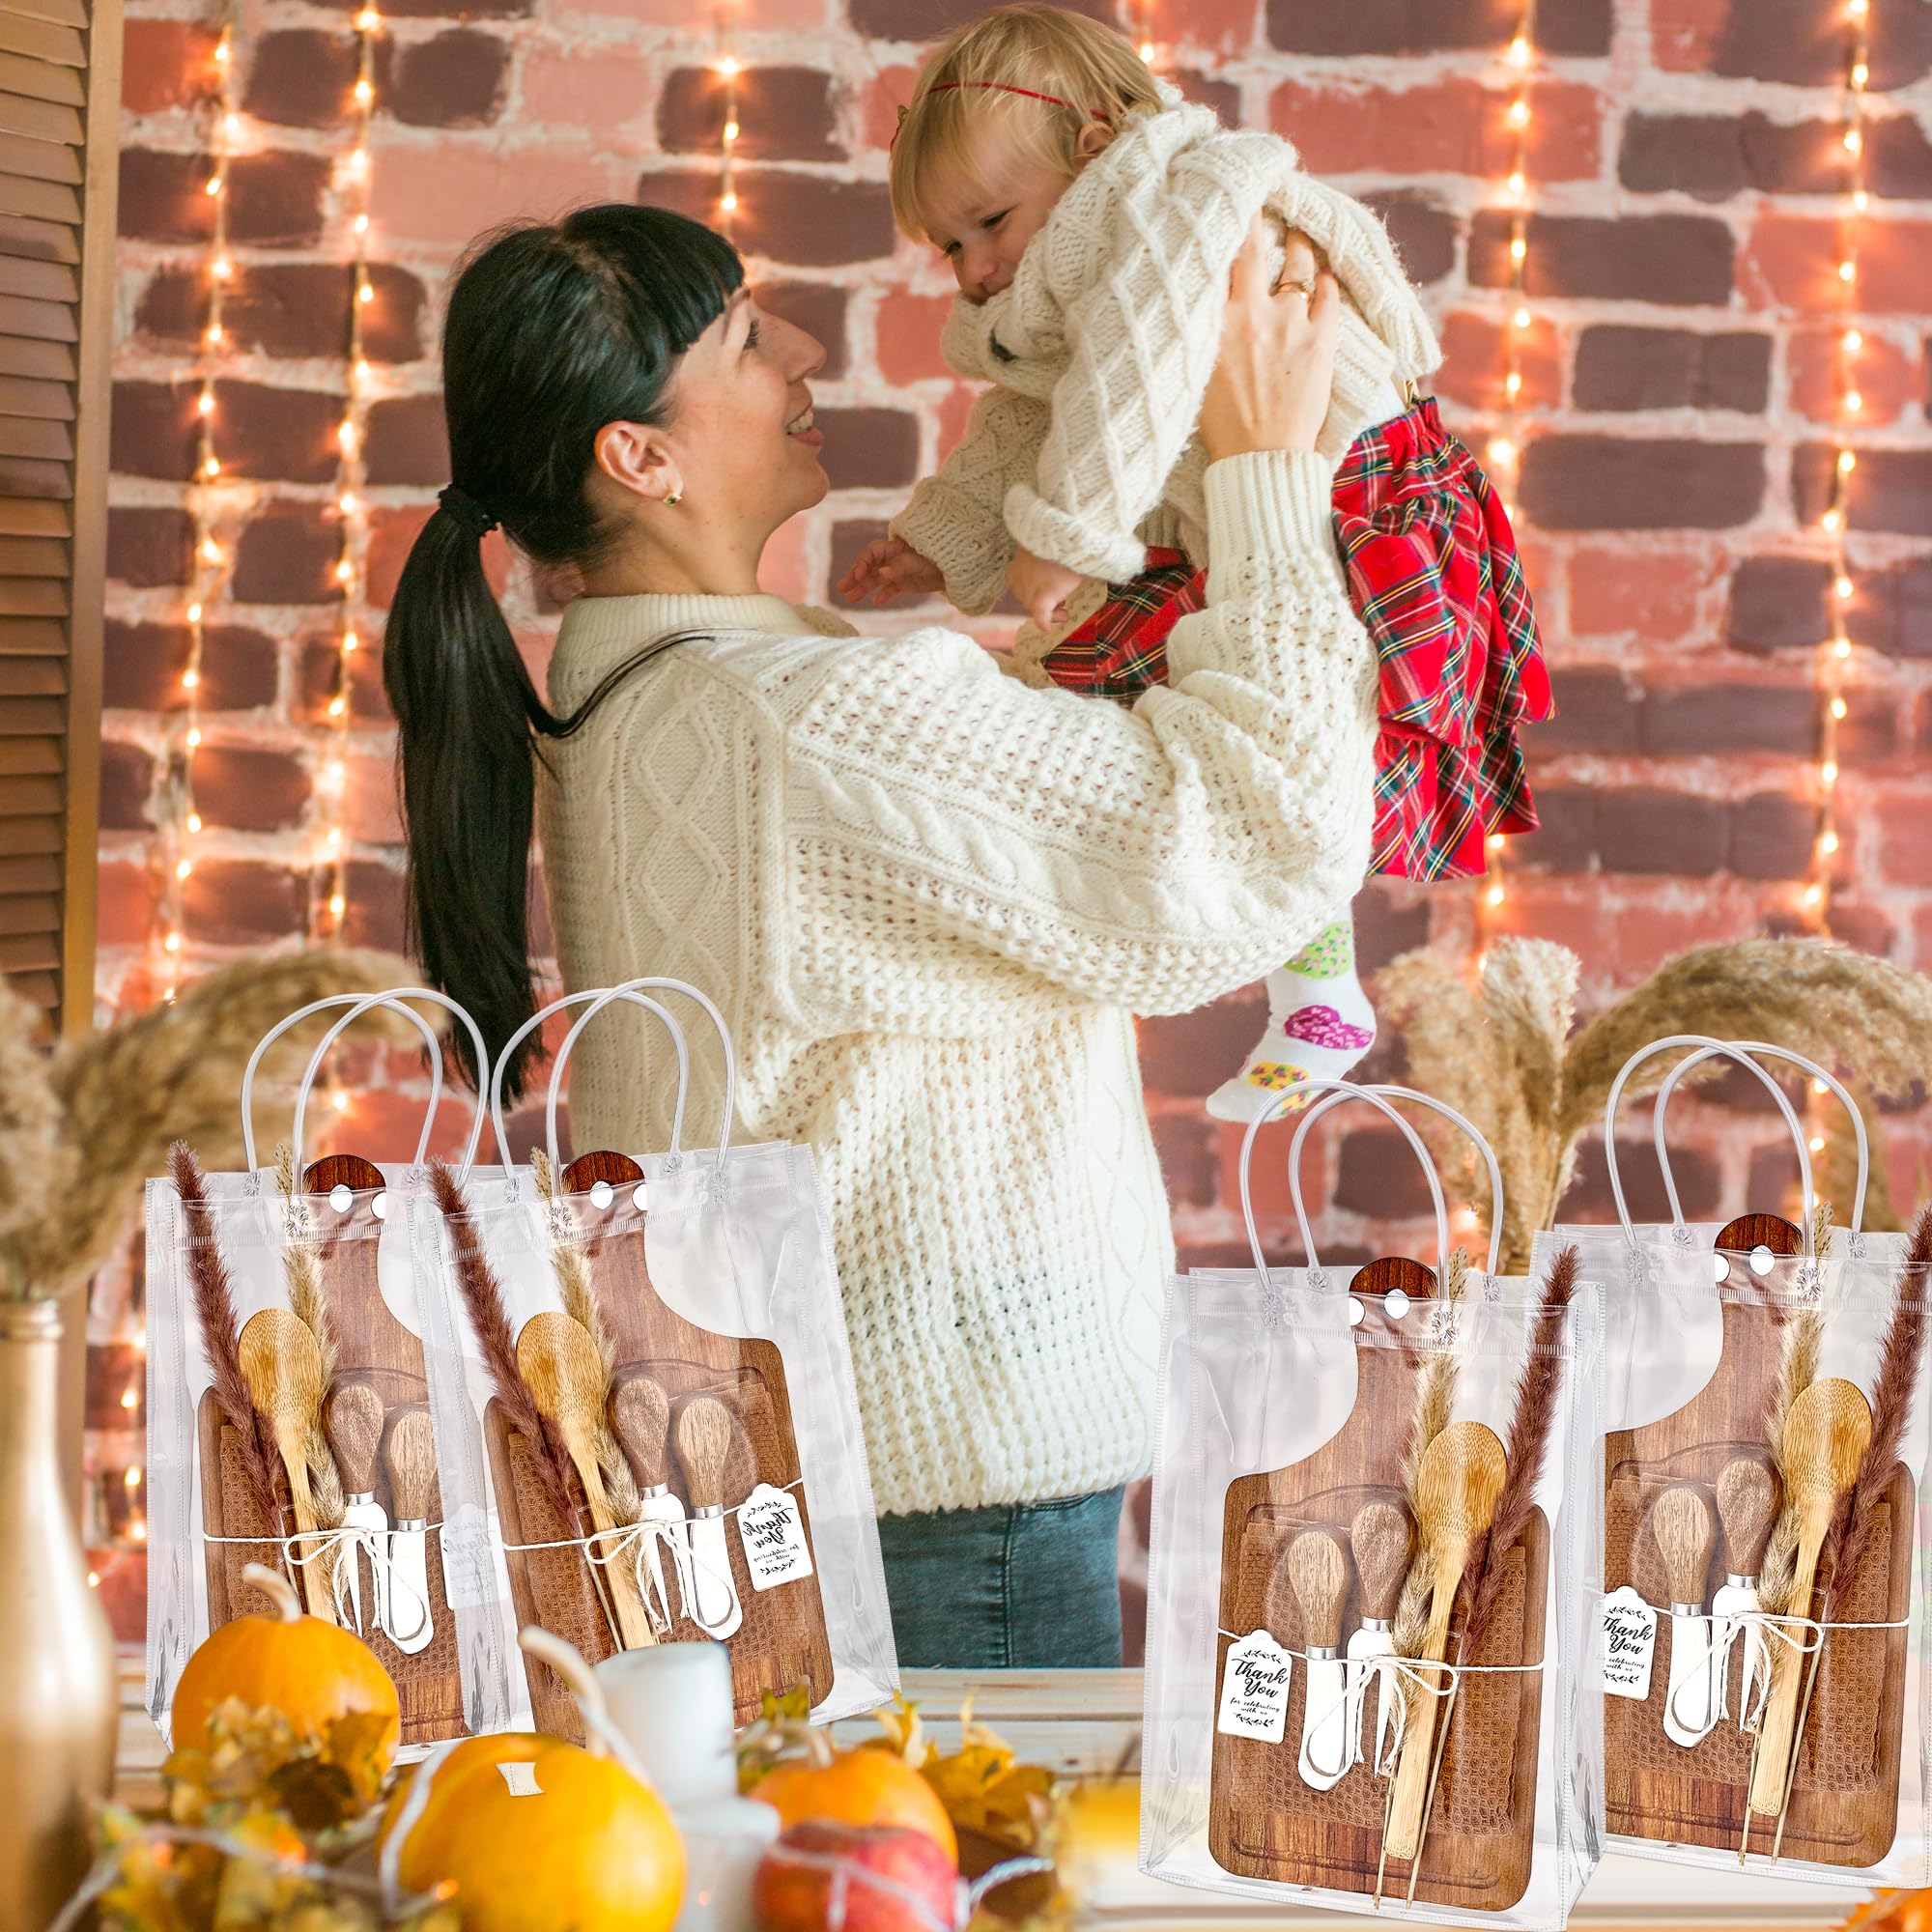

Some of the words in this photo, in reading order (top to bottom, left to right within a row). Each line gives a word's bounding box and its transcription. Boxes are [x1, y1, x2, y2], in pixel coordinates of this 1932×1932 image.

[1604, 1615, 1654, 1641] Thank
[1608, 1634, 1643, 1655] You
[1231, 1659, 1289, 1684] Thank
[1608, 1658, 1645, 1669] celebrating
[1243, 1677, 1279, 1698] You
[1243, 1700, 1280, 1713] celebrating
